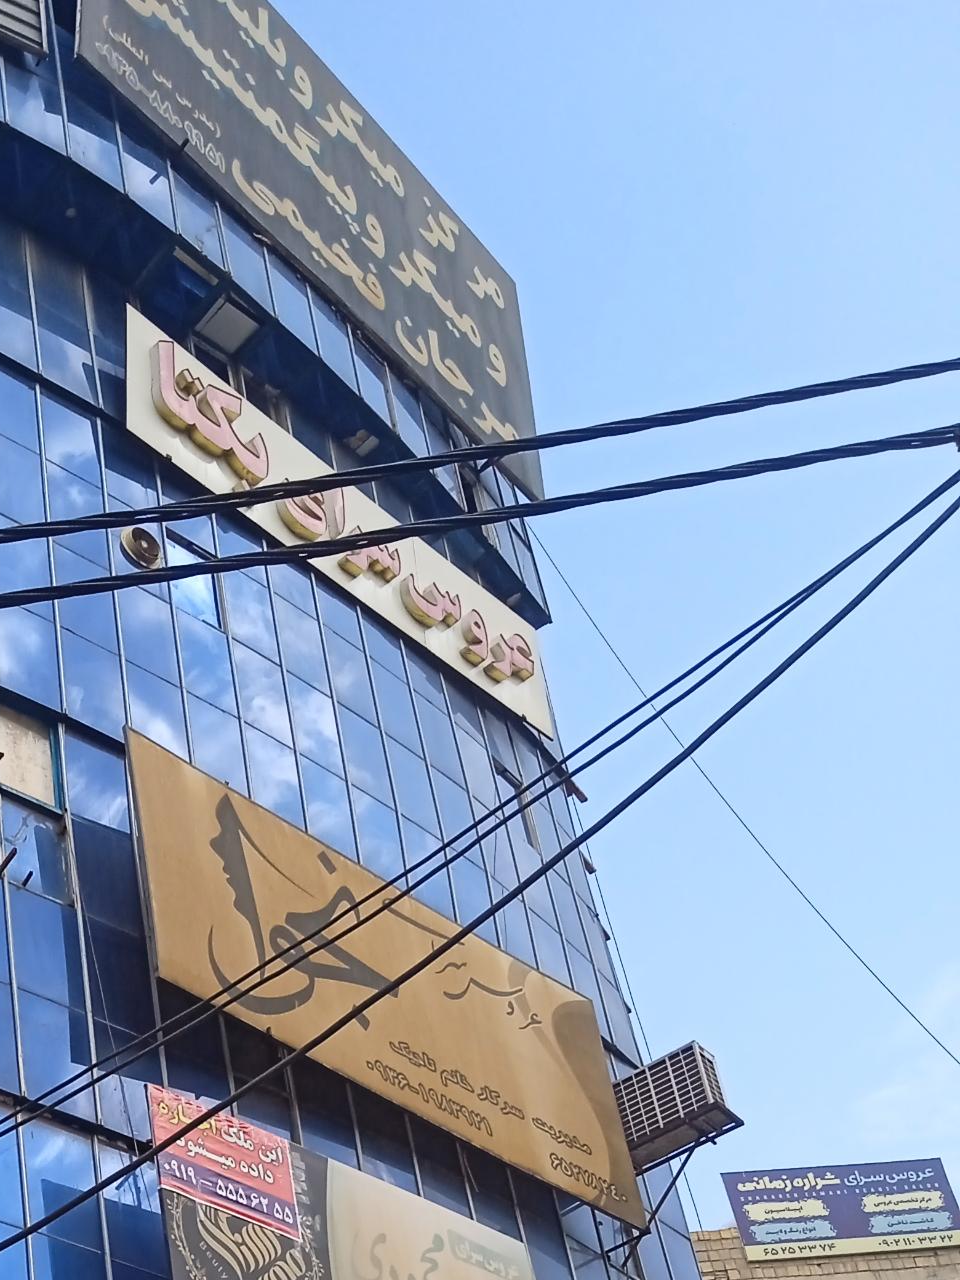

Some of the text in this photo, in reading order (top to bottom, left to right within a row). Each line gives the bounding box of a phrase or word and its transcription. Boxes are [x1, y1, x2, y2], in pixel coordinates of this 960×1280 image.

[150, 340, 269, 500] یکتا
[220, 1126, 255, 1151] ملک
[258, 1145, 284, 1165] این
[240, 1162, 275, 1184] داده
[737, 1167, 934, 1193] عروس سرای شراره زمانی
